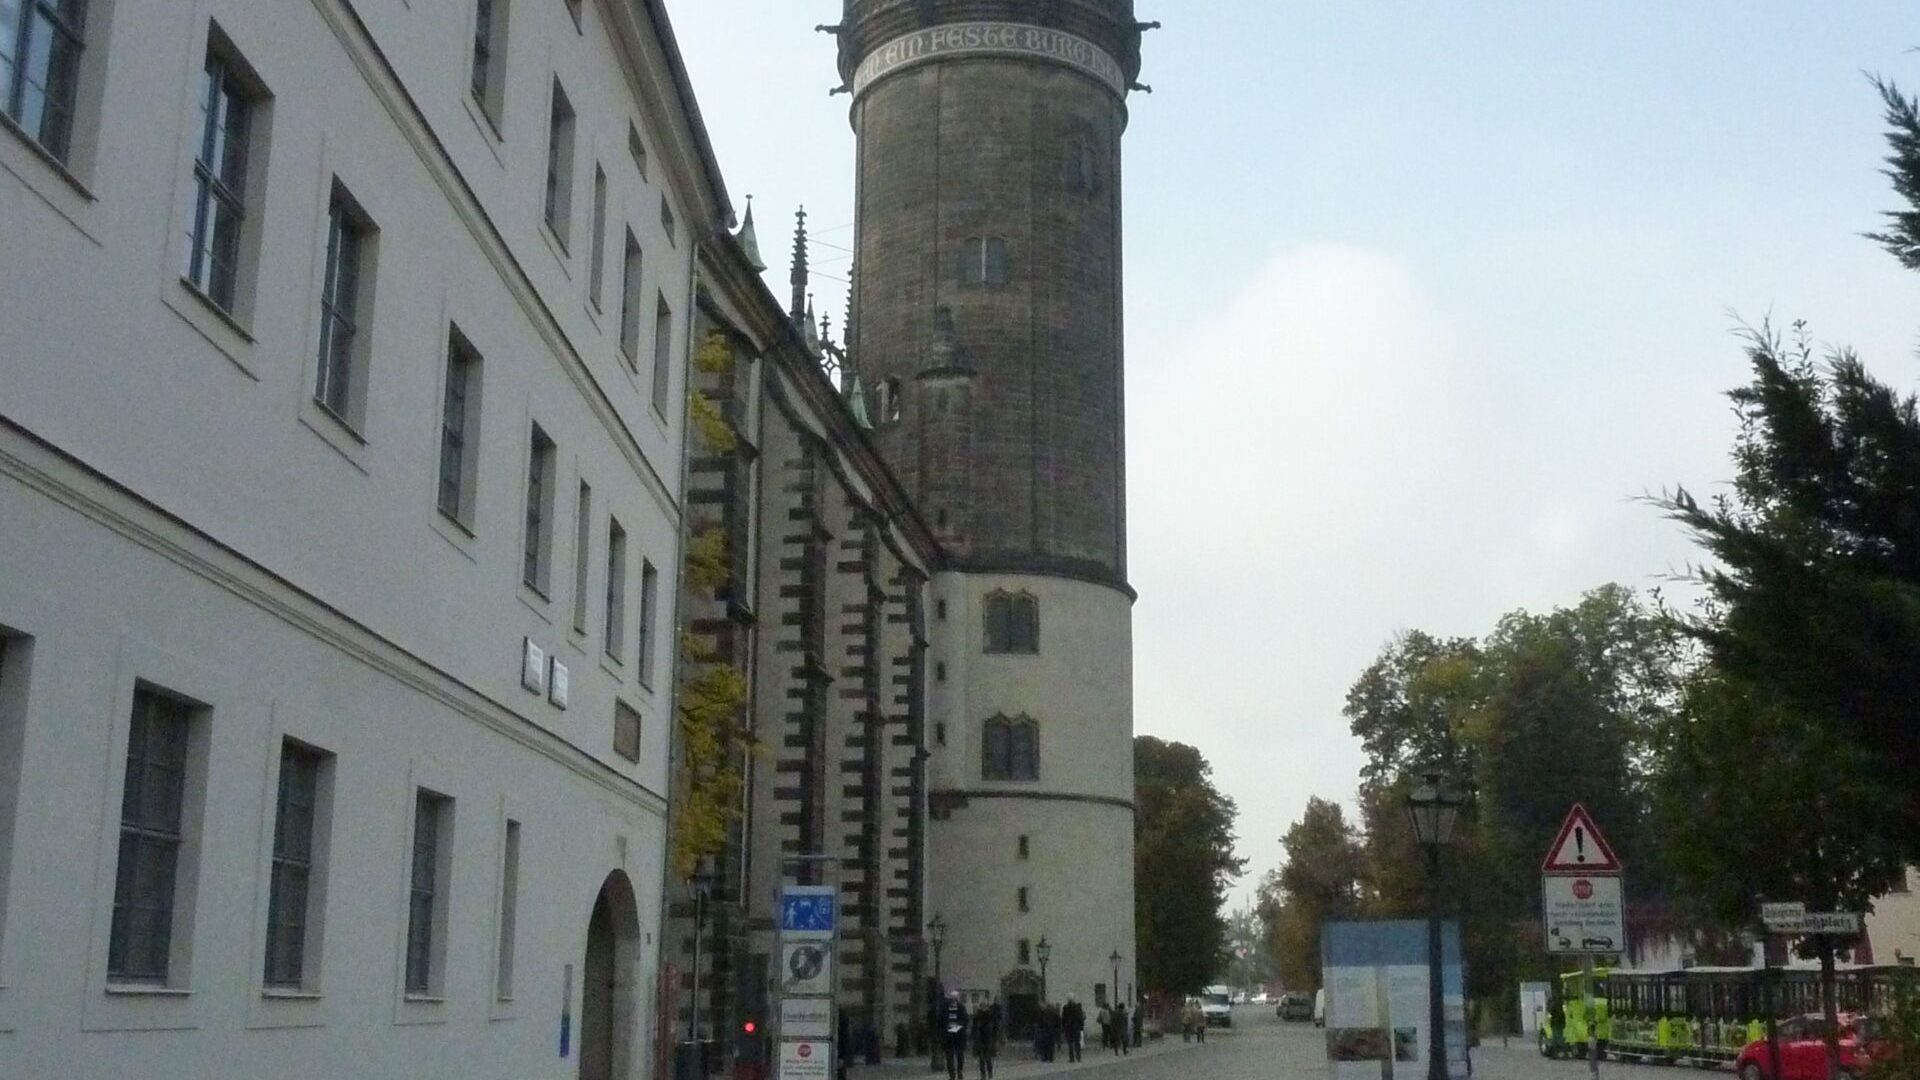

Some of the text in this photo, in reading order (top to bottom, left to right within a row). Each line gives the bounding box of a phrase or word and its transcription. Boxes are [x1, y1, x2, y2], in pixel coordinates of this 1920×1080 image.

[885, 35, 923, 65] EIN
[930, 26, 1018, 51] FESTE
[1025, 29, 1085, 64] BURG
